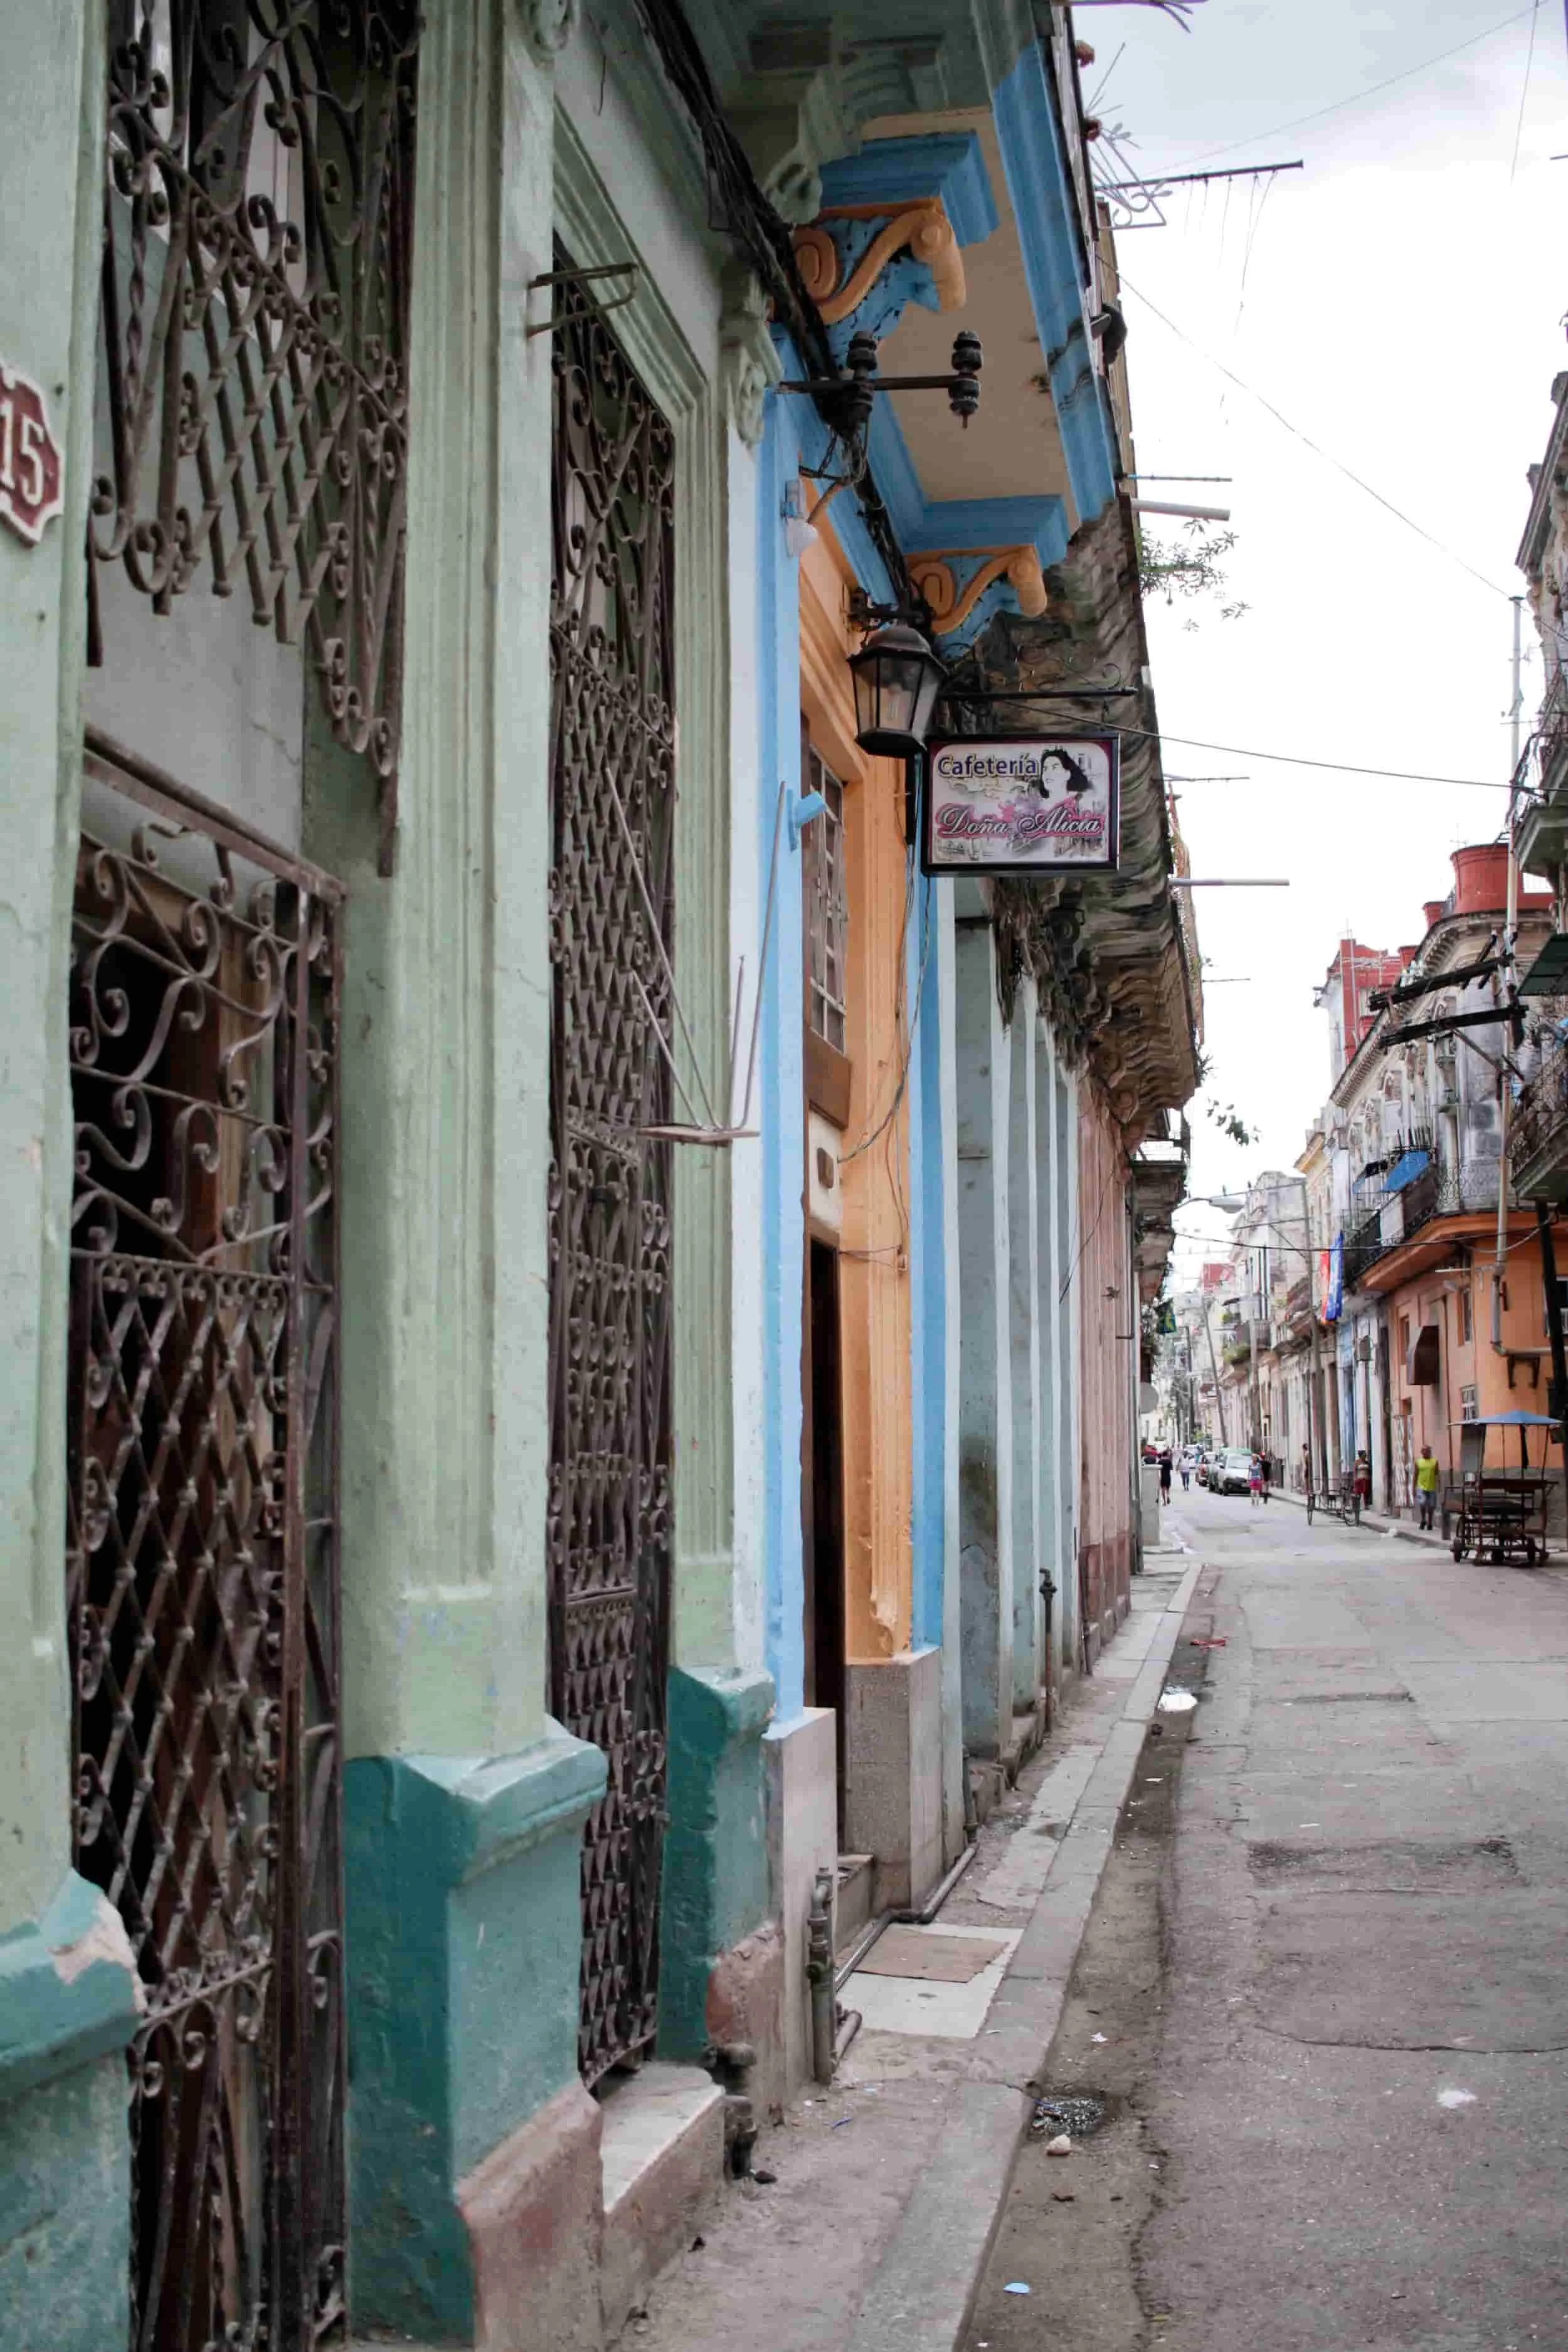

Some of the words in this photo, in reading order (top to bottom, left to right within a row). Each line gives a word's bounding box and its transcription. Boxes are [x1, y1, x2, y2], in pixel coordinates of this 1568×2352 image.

[938, 753, 1037, 775] Cafetería
[942, 805, 1009, 835] Doña
[1017, 806, 1100, 834] Alicia
